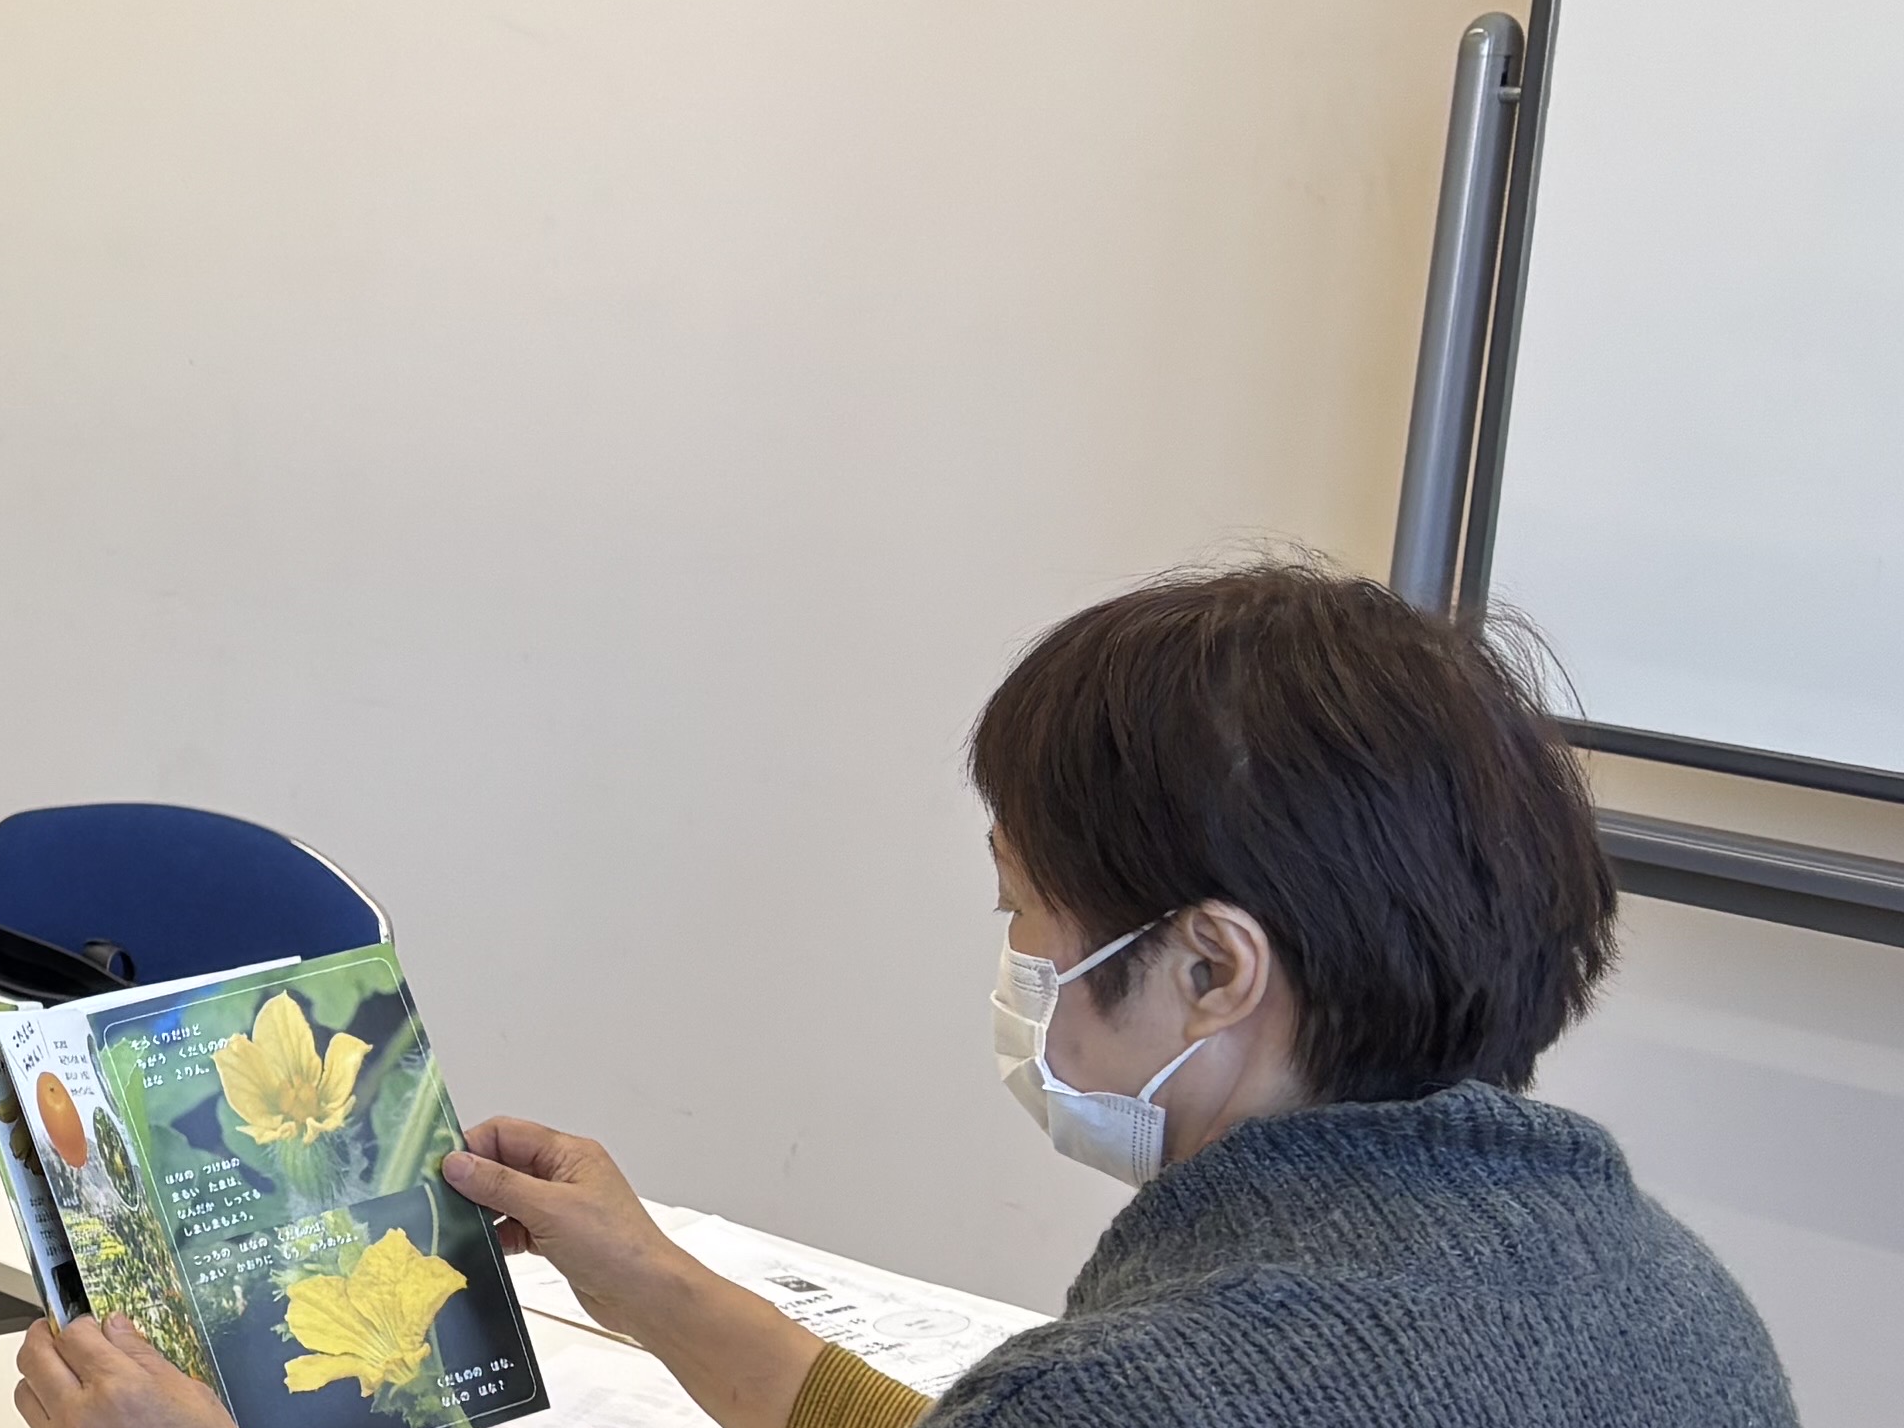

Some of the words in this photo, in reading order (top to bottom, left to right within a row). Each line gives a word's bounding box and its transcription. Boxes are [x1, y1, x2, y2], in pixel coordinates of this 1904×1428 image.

[131, 1023, 202, 1051] そっくりだけど
[178, 1037, 229, 1059] くだものの
[142, 1074, 165, 1089] はな
[165, 1169, 195, 1185] はなの
[202, 1157, 241, 1175] つけねの
[171, 1187, 200, 1203] まるい
[208, 1176, 243, 1194] たまは、
[176, 1202, 215, 1220] なんだか
[223, 1188, 262, 1208] しってる
[183, 1210, 254, 1237] しましまもよう。
[193, 1247, 232, 1266] こっちの
[238, 1237, 269, 1254] はなの
[199, 1266, 228, 1284] あまい
[236, 1254, 274, 1273] かおりに
[436, 1366, 483, 1388] くだものの
[441, 1391, 470, 1408] なんの
